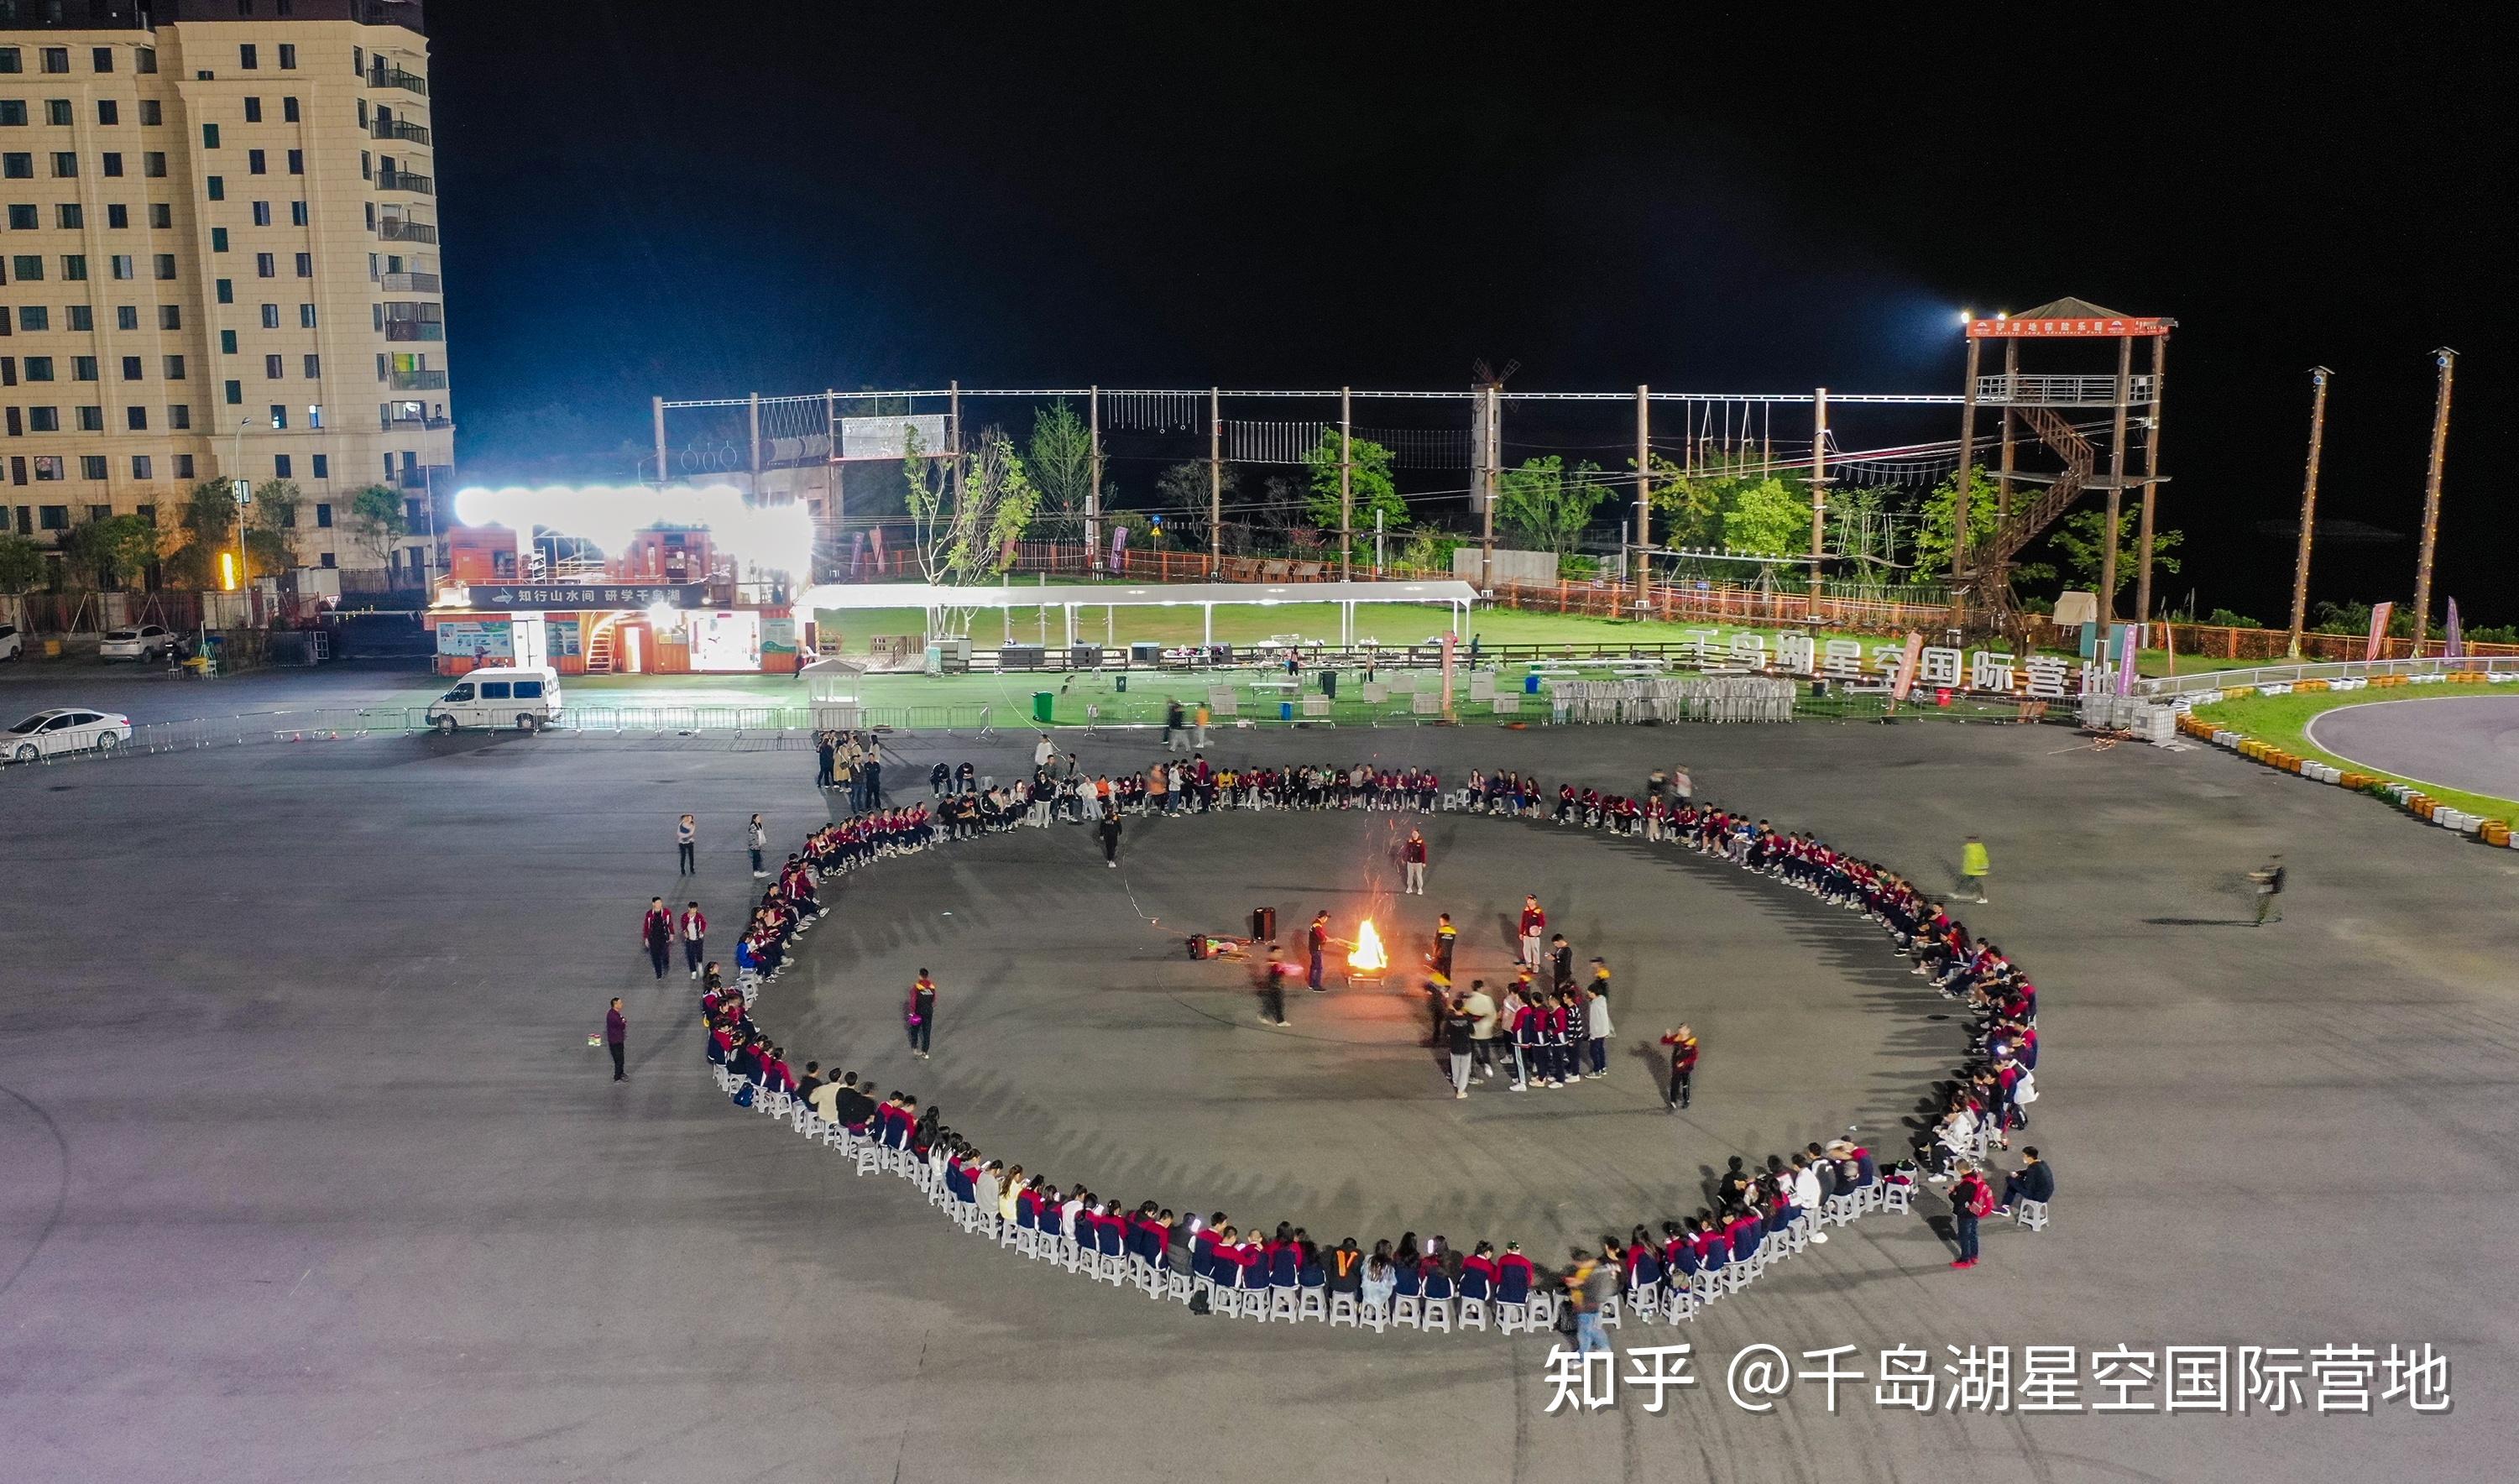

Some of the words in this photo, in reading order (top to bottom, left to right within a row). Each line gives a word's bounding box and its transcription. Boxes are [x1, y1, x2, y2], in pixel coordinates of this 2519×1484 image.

[518, 590, 594, 602] 知行山水间
[604, 589, 681, 602] 研学千岛湖
[1681, 630, 2112, 698] 千岛湖星空国际营地
